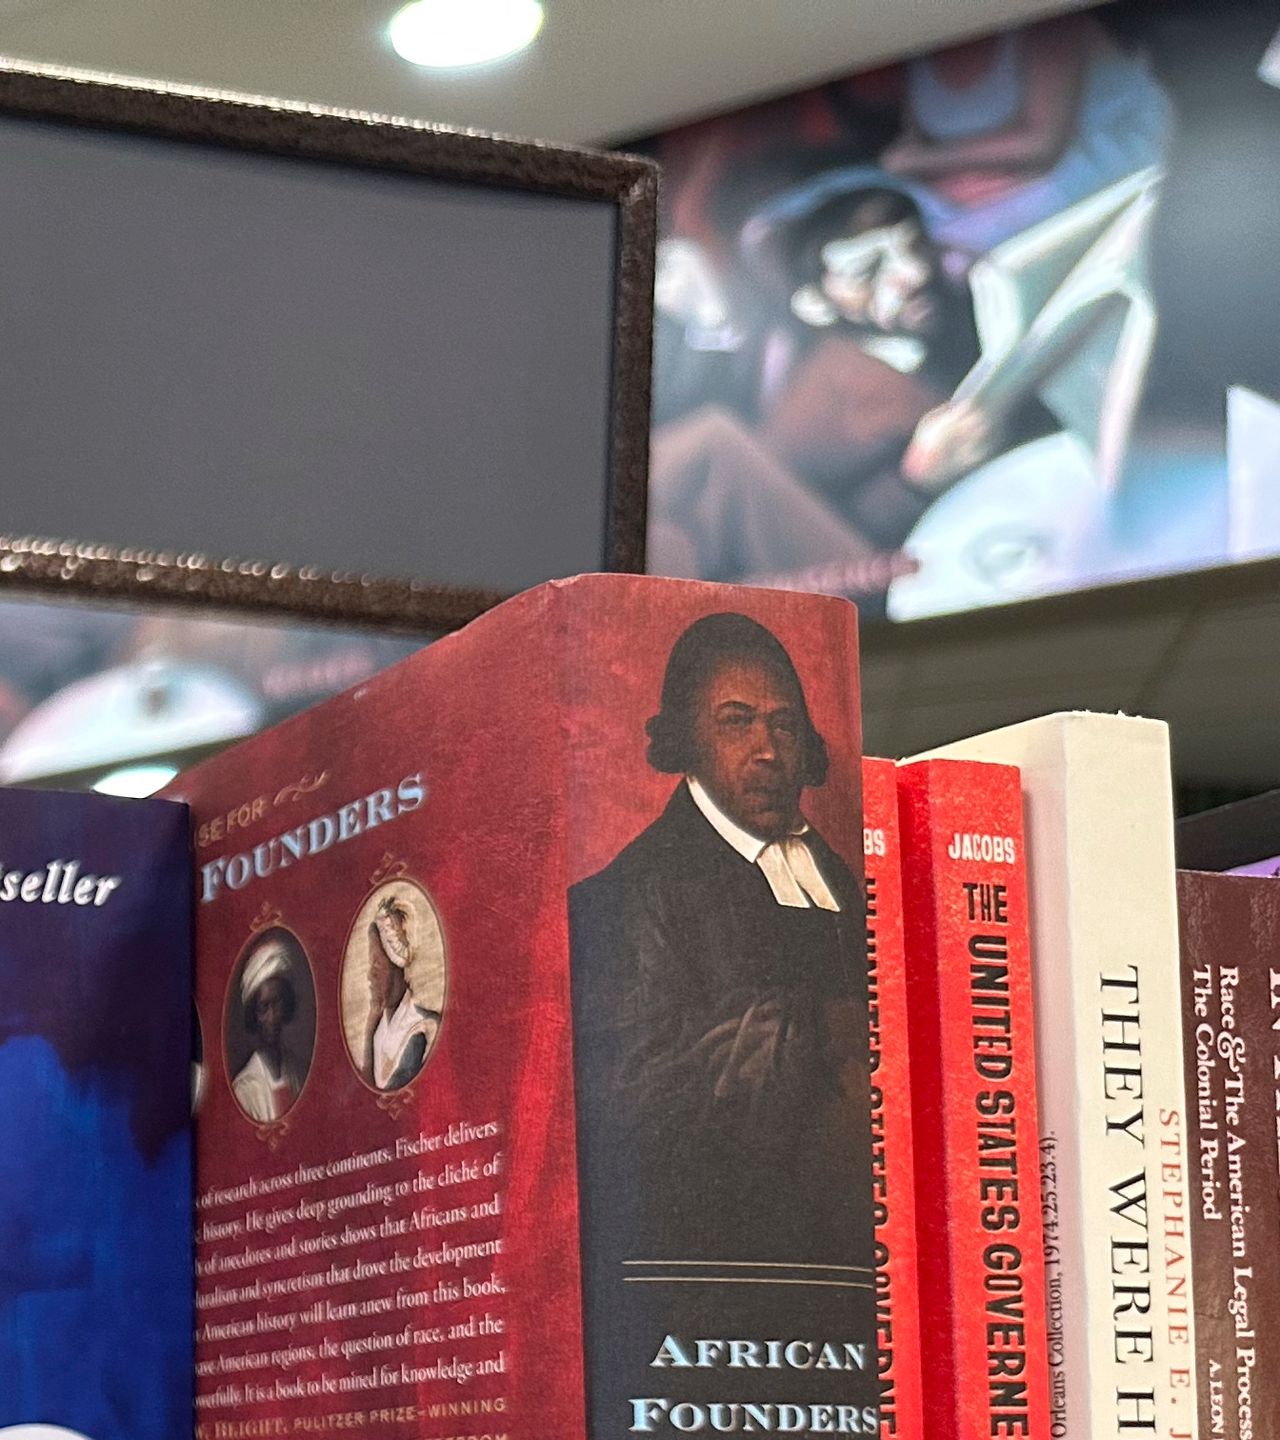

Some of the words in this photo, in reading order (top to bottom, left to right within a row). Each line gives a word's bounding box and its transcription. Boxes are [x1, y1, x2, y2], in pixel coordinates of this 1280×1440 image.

[200, 773, 428, 903] FOUNDERS
[948, 832, 1015, 864] JACOBS
[962, 882, 1008, 923] THE
[967, 933, 1014, 1083] UNITED
[1193, 964, 1213, 1018] The
[1219, 965, 1239, 1031] Race
[1099, 964, 1146, 1150] THEY
[1195, 1022, 1219, 1131] Colonial
[1216, 1031, 1246, 1073] &
[1224, 1067, 1245, 1127] The
[974, 1088, 1022, 1233] STATES
[1198, 1138, 1223, 1221] Period
[1158, 1107, 1191, 1346] STEPHANIE
[1227, 1130, 1251, 1259] American
[1109, 1167, 1154, 1365] WERE
[1228, 1265, 1255, 1339] Legal
[649, 1334, 867, 1371] AFRICAN
[1208, 1358, 1222, 1379] A.
[627, 1398, 879, 1436] FOUNDERS
[1169, 1367, 1192, 1405] E.
[1208, 1380, 1226, 1433] LEON
